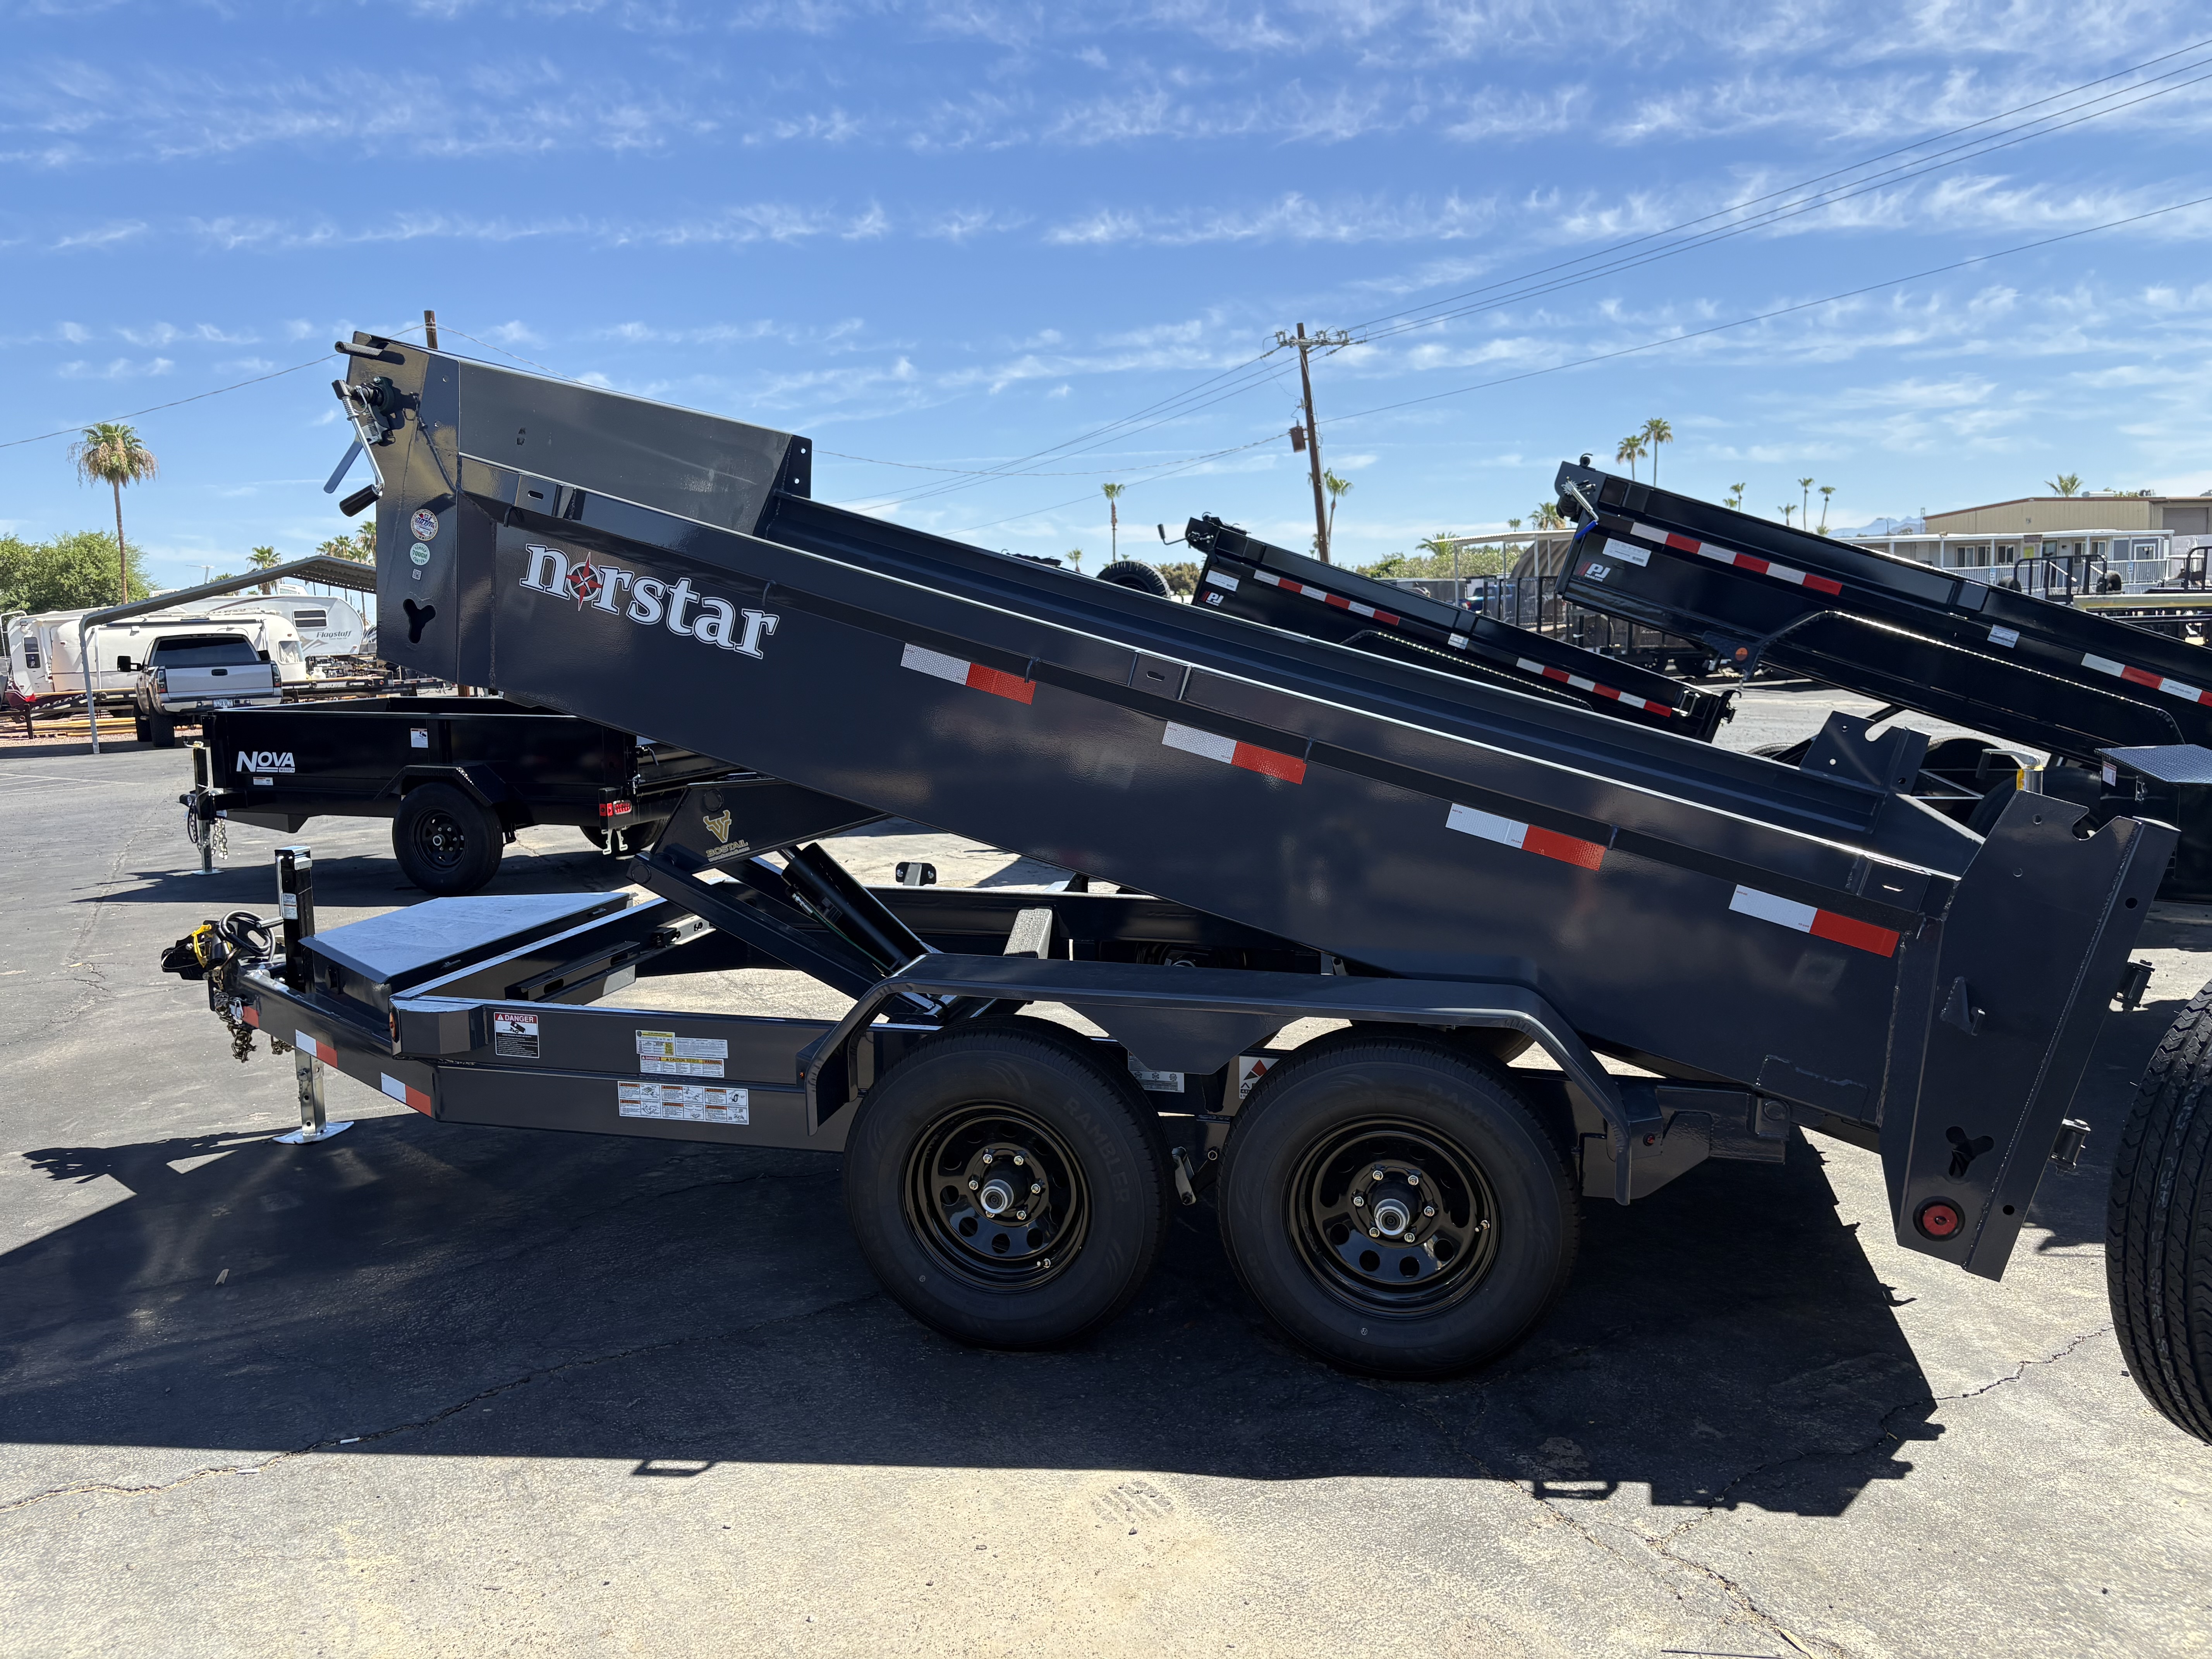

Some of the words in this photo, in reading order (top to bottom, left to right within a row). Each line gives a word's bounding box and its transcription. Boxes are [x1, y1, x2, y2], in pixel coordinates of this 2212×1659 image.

[1587, 563, 1611, 579] PJ
[520, 544, 779, 659] norstar
[1207, 592, 1224, 604] PJ
[236, 751, 295, 772] NOVA
[706, 840, 748, 857] BOSTAIL
[505, 1015, 534, 1023] DANGER
[1063, 1096, 1130, 1204] RAMBLER
